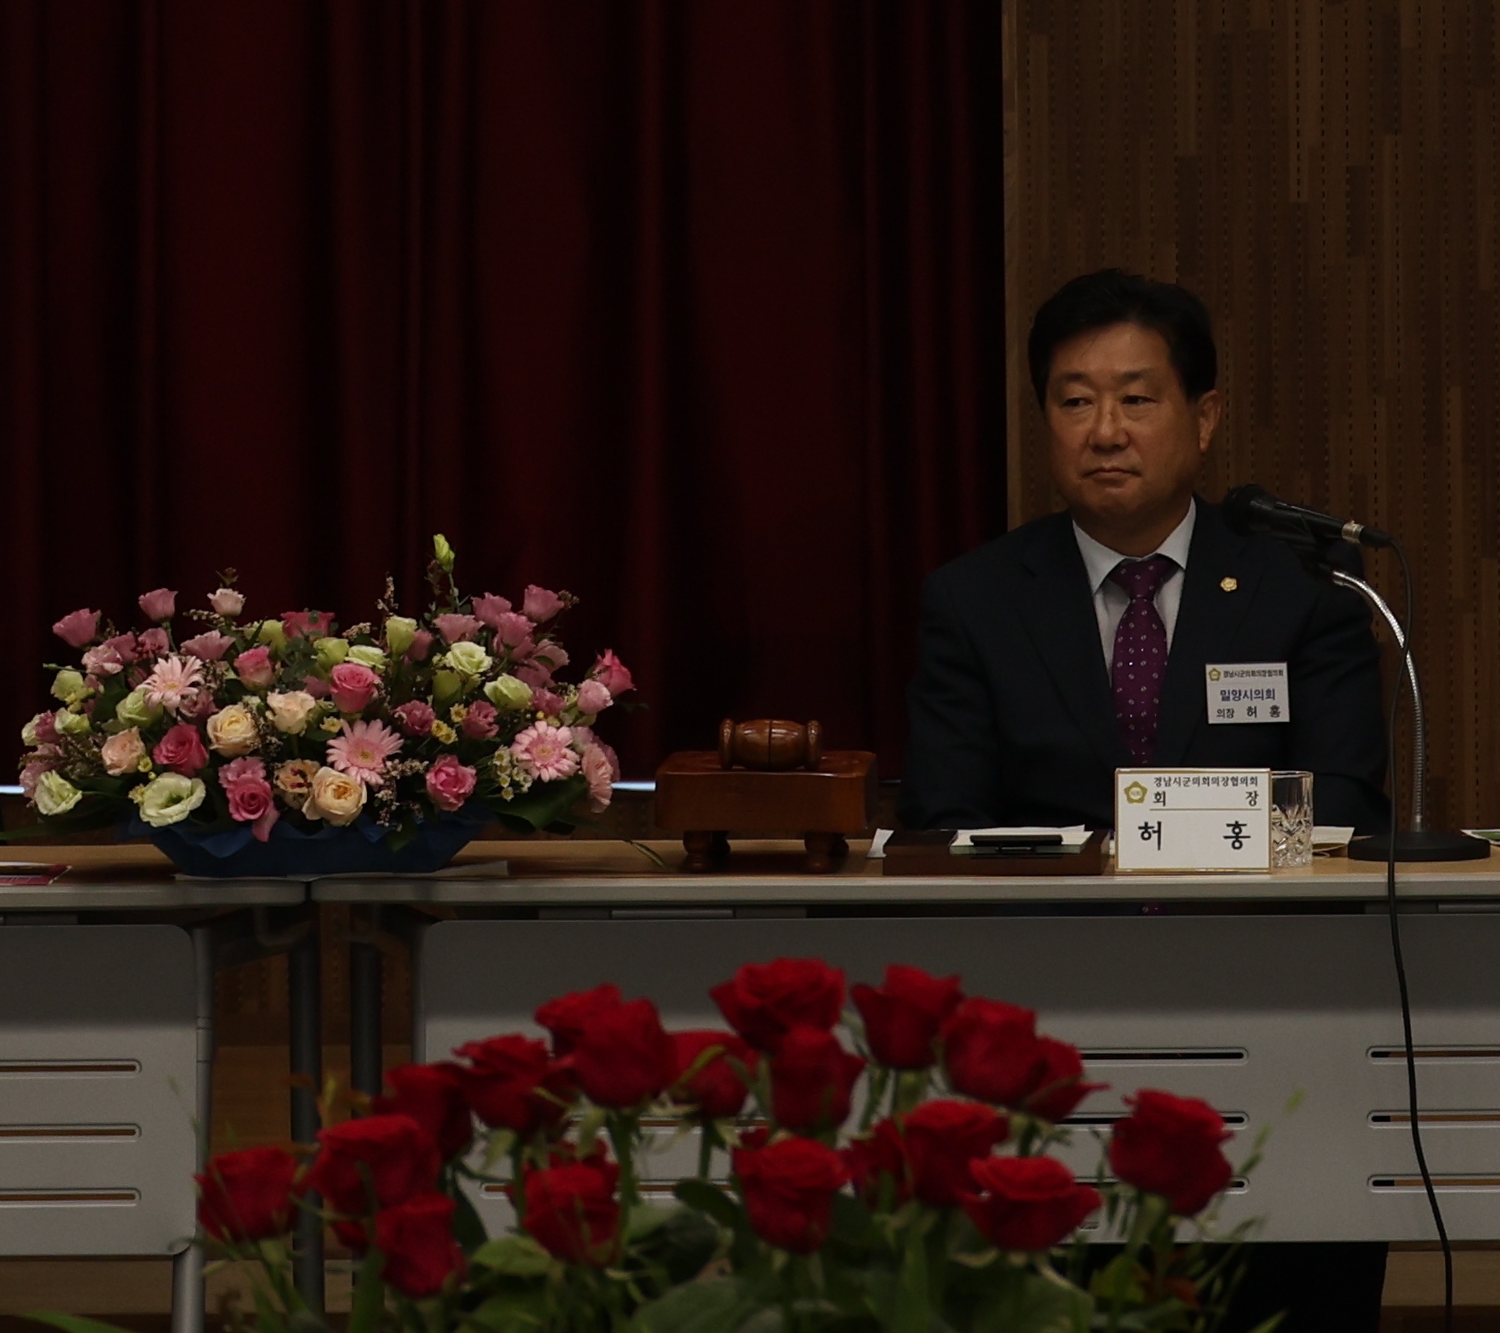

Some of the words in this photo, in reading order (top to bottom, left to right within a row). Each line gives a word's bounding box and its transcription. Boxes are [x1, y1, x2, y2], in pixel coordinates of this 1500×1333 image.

[1219, 688, 1276, 702] 밀양시의회
[1216, 707, 1235, 719] 의장
[1153, 775, 1259, 788] 경남시군의회의장협의회
